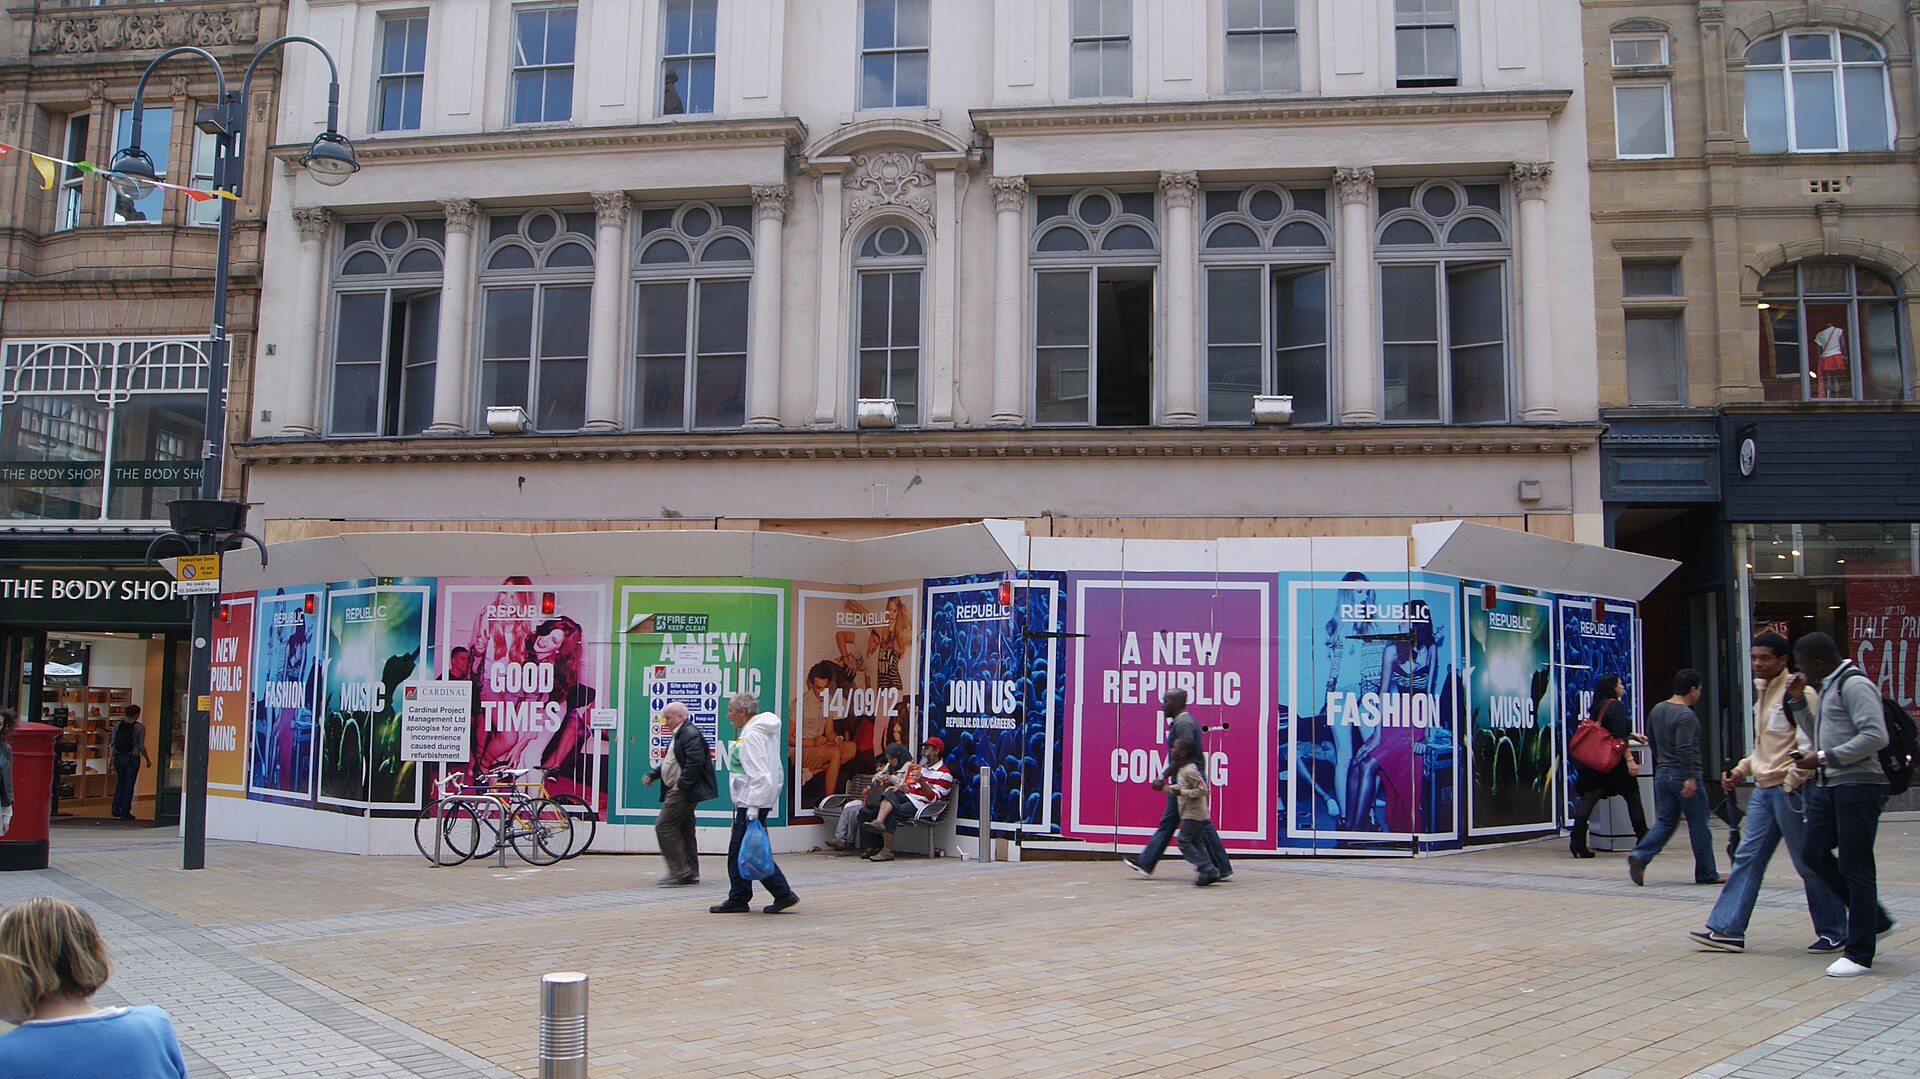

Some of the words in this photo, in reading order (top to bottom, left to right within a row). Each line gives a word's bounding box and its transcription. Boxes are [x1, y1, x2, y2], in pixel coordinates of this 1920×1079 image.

[2, 469, 25, 480] THE
[30, 468, 65, 480] BODY
[116, 469, 139, 480] THE
[144, 468, 180, 480] BODY
[183, 468, 204, 480] SH
[1, 580, 44, 599] THE
[51, 580, 116, 600] BODY
[273, 612, 304, 624] REPUBLIC
[487, 605, 562, 618] REPUB
[667, 615, 685, 624] FIRE
[688, 616, 707, 624] EXIT
[836, 611, 890, 625] REPUBLIC
[956, 603, 1010, 619] REPUBLIC
[1341, 604, 1430, 620] REPUBLIC
[1489, 612, 1532, 630] REPUBLIC
[1580, 621, 1616, 636] REPUBLIC
[1853, 616, 1889, 639] HALF
[216, 638, 239, 662] NEW
[659, 632, 676, 662] A
[1122, 632, 1141, 665] A
[1153, 632, 1222, 666] NEW
[210, 666, 242, 692] PUBLIC
[490, 662, 555, 693] GOOD
[670, 667, 712, 675] CARDINAL
[265, 681, 306, 709] FASHION
[340, 681, 386, 713] MUSIC
[422, 688, 466, 696] CARDINAL
[946, 680, 985, 713] JOIN
[991, 680, 1016, 714] US
[1103, 670, 1241, 706] REPUBLIC
[213, 696, 224, 722] IS
[440, 706, 465, 715] Project
[819, 687, 899, 718] 14/09/12
[1326, 691, 1440, 729] FASHION
[1490, 695, 1535, 729] MUSIC
[1578, 690, 1594, 720] JO
[408, 715, 453, 724] Management
[454, 715, 466, 723] Ltd
[481, 701, 561, 733] TIMES
[945, 716, 1016, 730] REPUBLIC.CO.UK/CAREERS
[209, 725, 236, 752] MING
[406, 725, 440, 733] apologise
[411, 751, 460, 759] refurbishment
[438, 743, 460, 751] during
[1110, 749, 1229, 787] COMG
